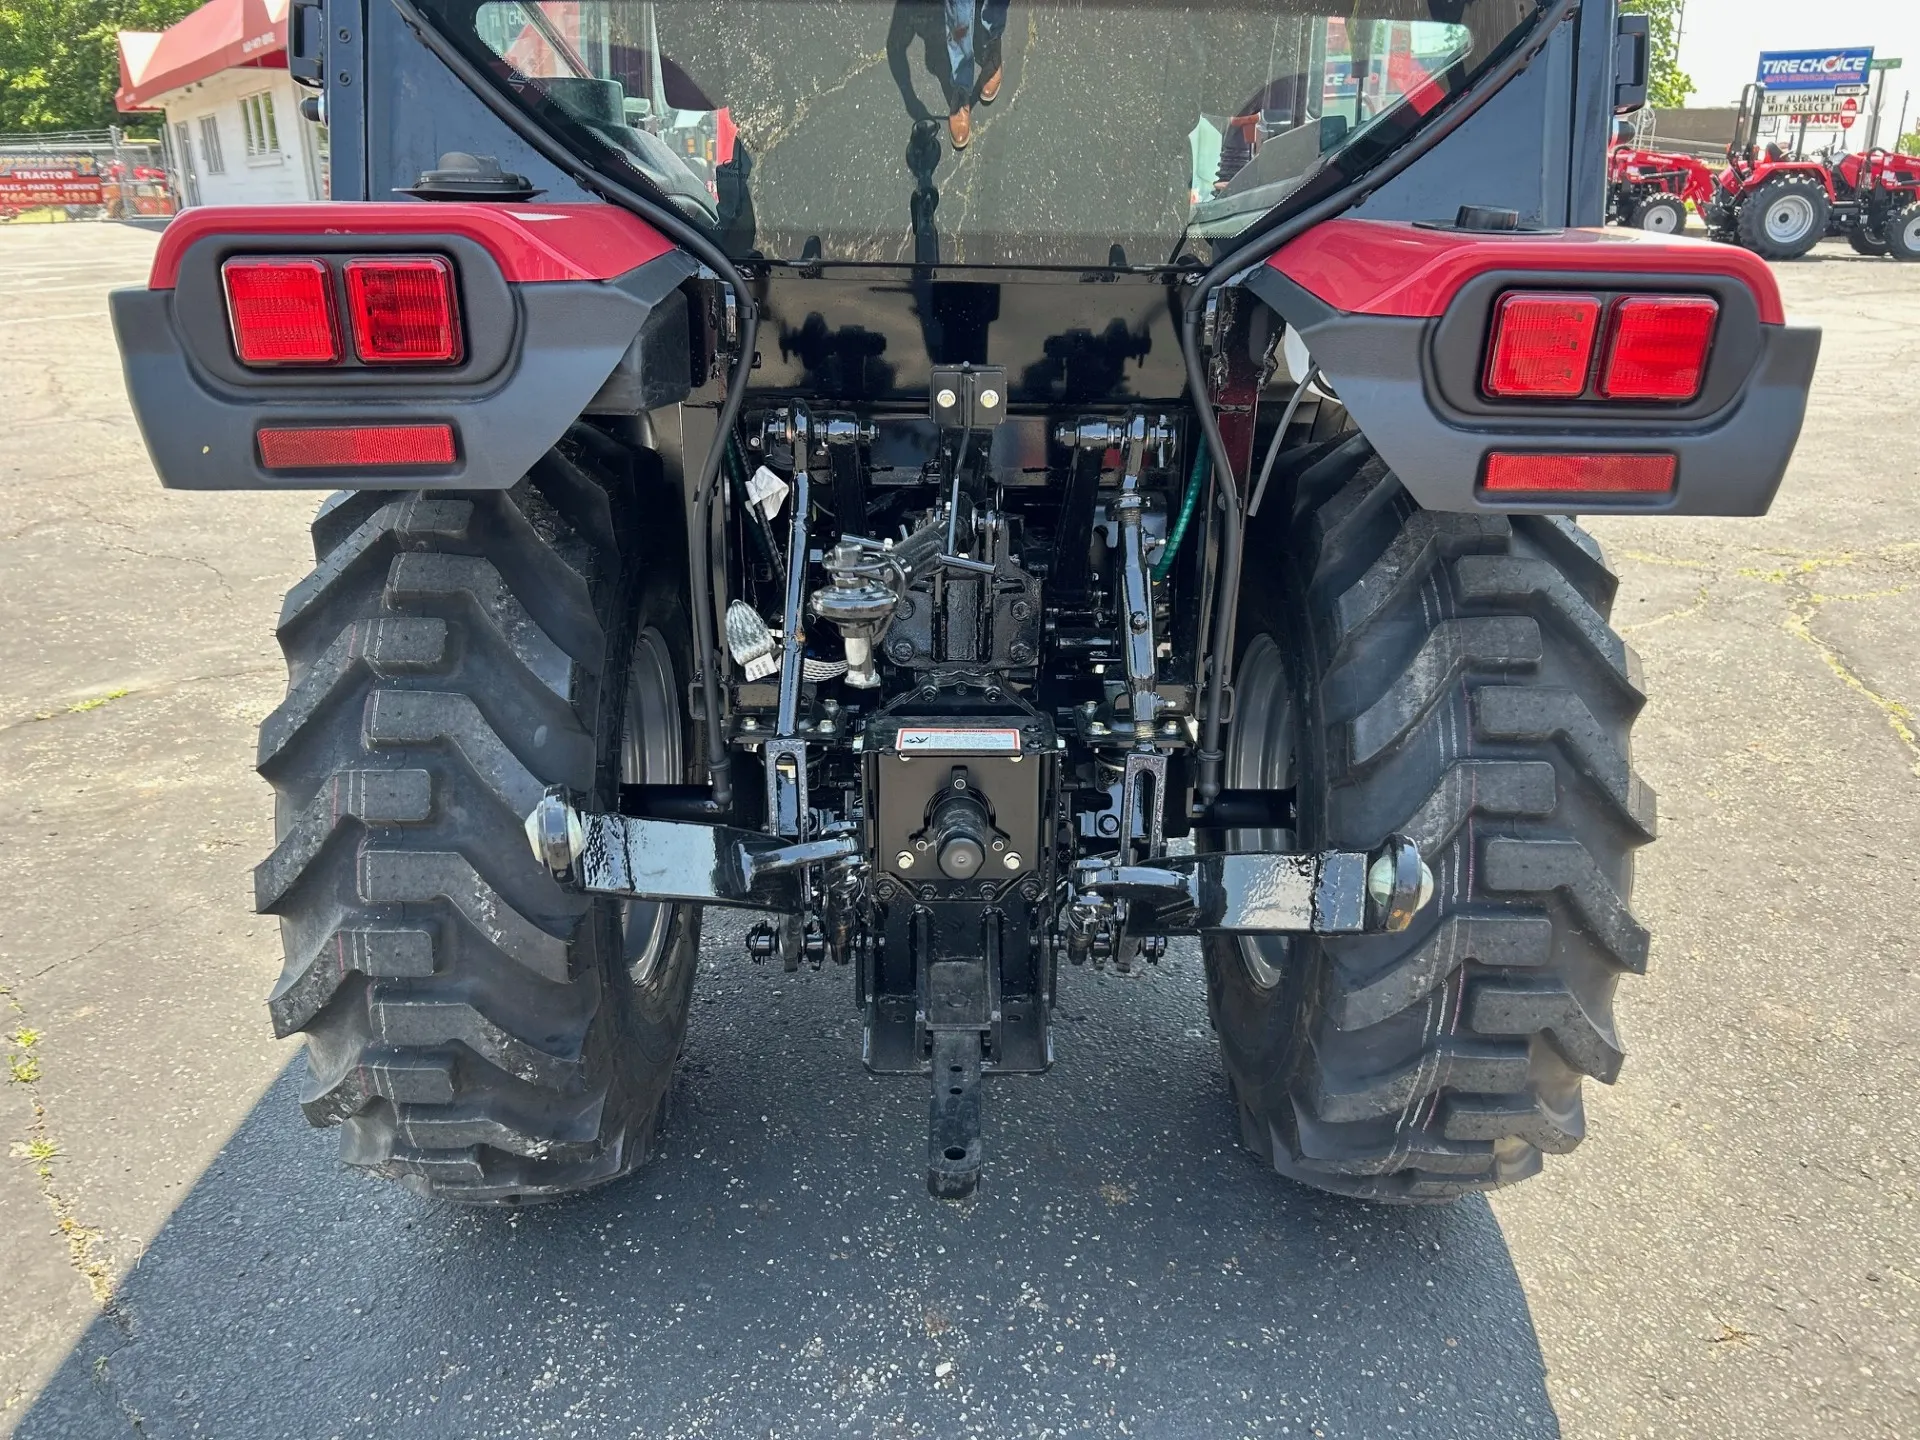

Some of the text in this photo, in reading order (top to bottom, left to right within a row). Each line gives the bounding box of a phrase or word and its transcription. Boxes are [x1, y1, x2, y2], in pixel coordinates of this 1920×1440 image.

[1786, 94, 1835, 103] ALIGNMENT
[1768, 104, 1790, 112] WITH
[1792, 103, 1825, 112] SELECT
[14, 171, 74, 180] TRACTOR
